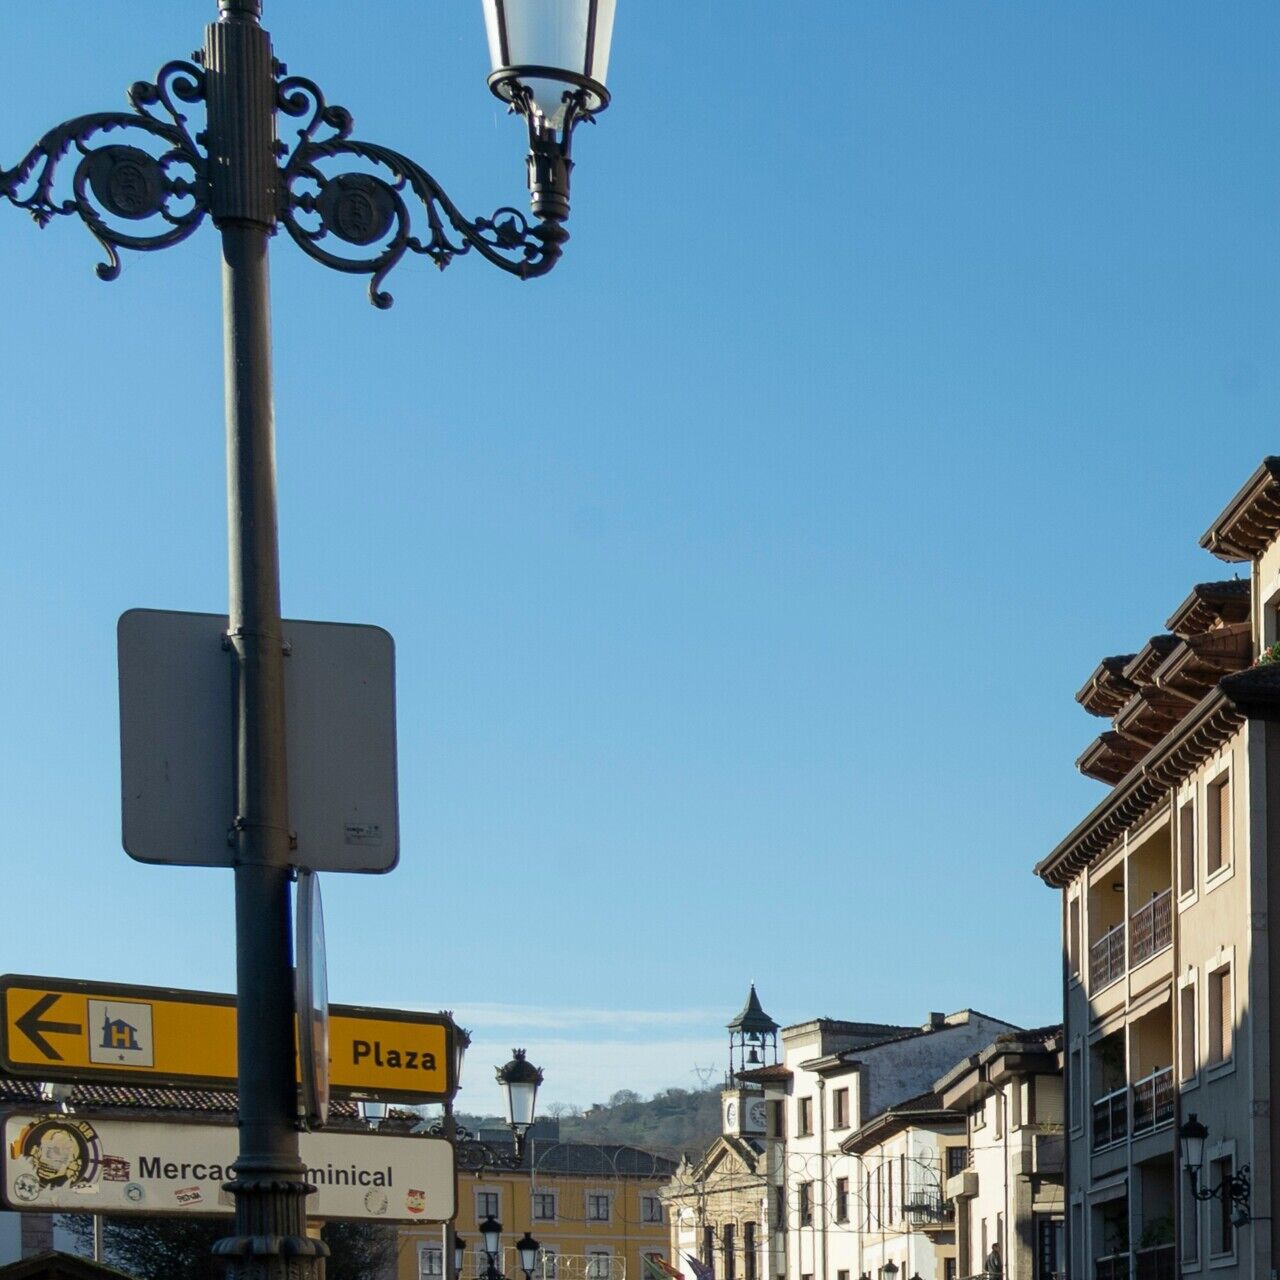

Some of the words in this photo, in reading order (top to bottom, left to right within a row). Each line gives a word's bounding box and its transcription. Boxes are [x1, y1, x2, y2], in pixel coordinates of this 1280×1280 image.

[352, 1039, 438, 1072] Plaza
[138, 1156, 237, 1181] Merca
[303, 1164, 393, 1187] minical
